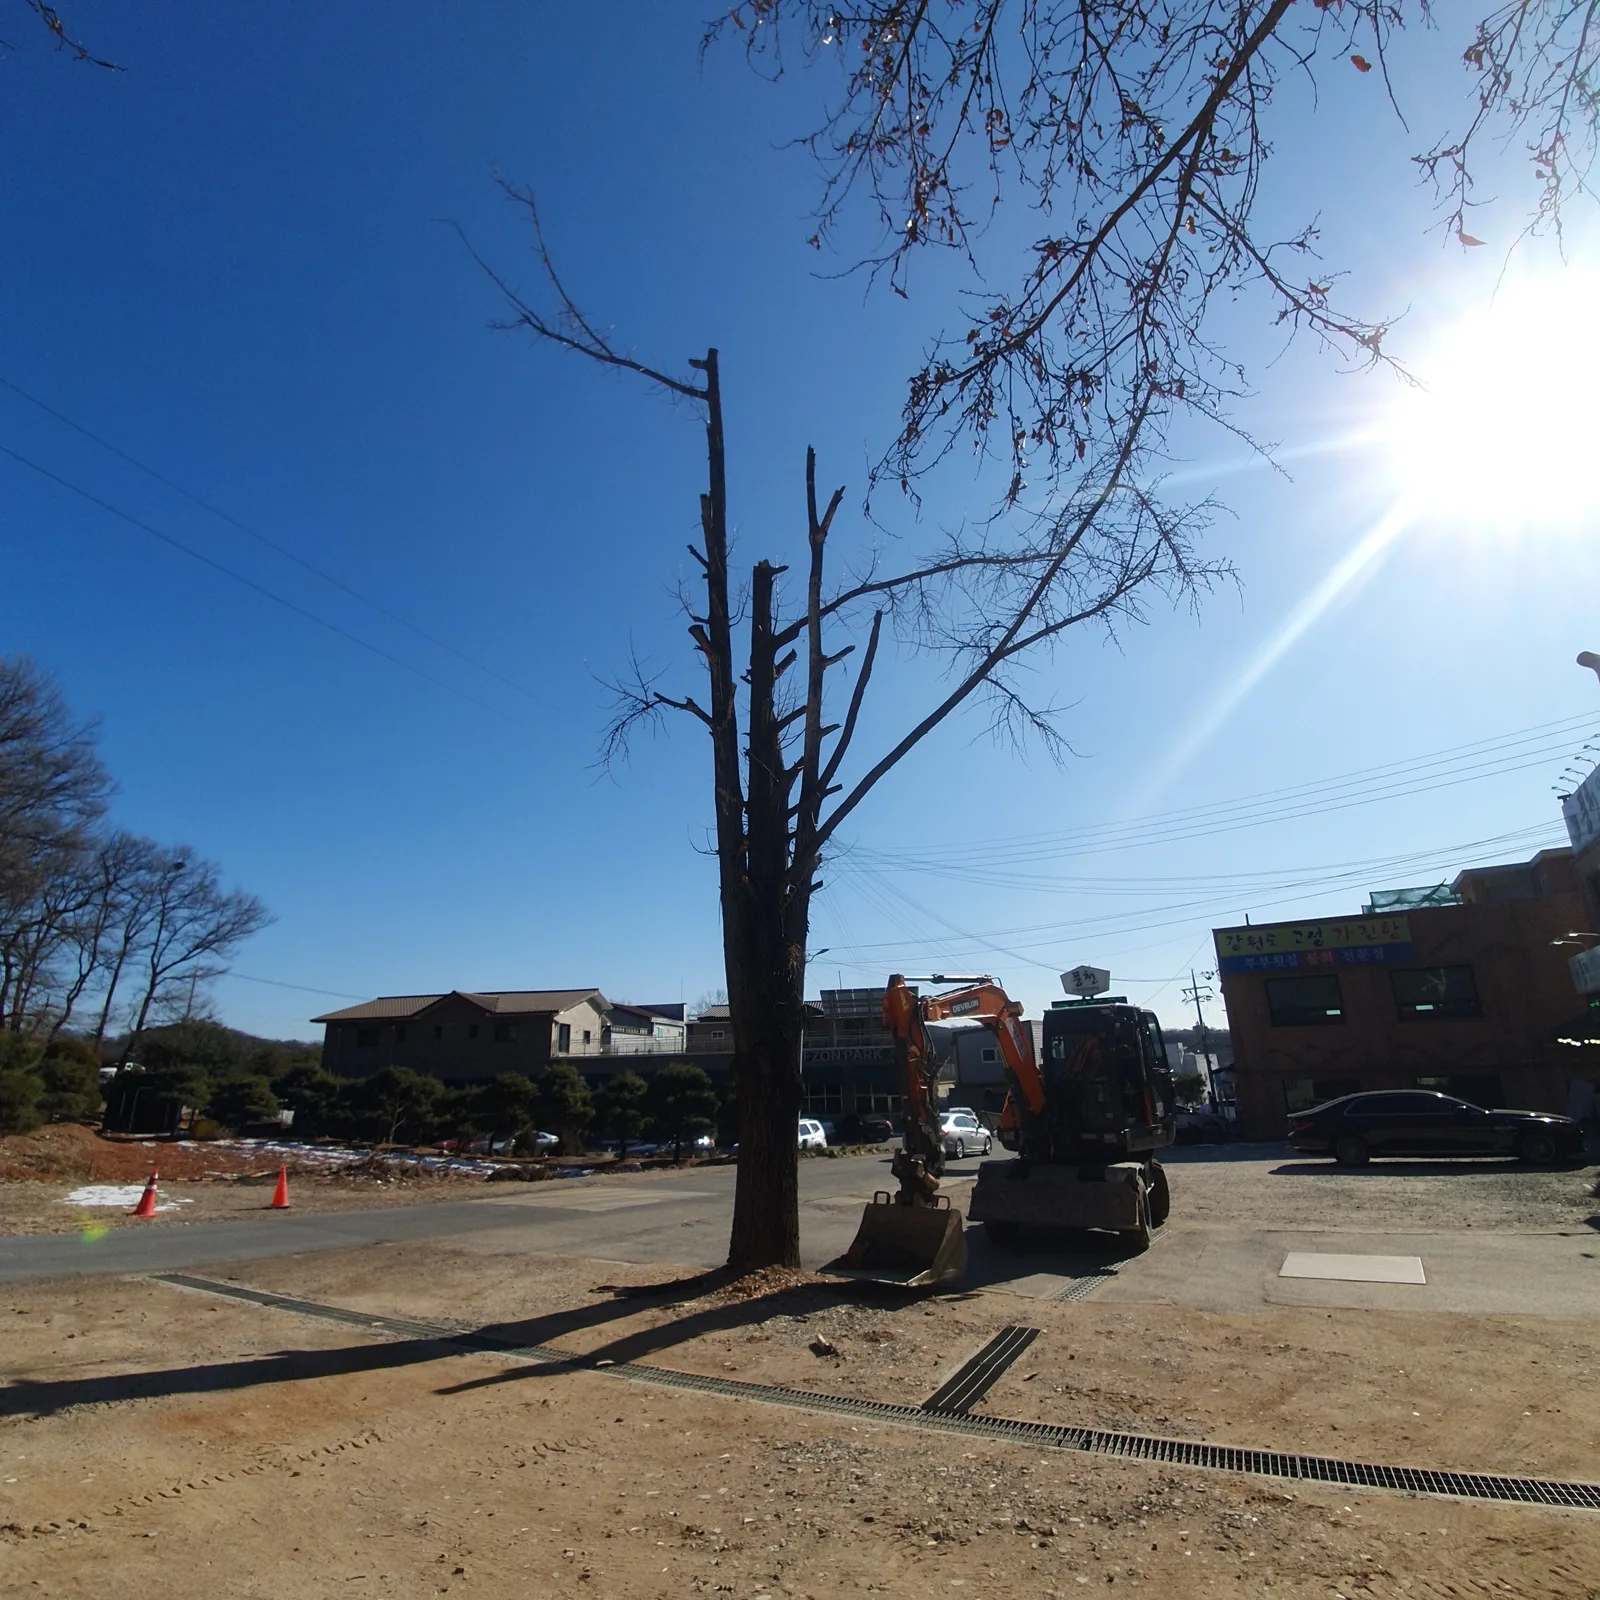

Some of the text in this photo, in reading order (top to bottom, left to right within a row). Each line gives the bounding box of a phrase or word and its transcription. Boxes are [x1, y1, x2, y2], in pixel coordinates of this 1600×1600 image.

[1226, 920, 1400, 951] 강원도 고성 가진항
[1342, 947, 1385, 962] 전문점
[952, 999, 979, 1013] DEVELON
[842, 1048, 882, 1061] PARK
